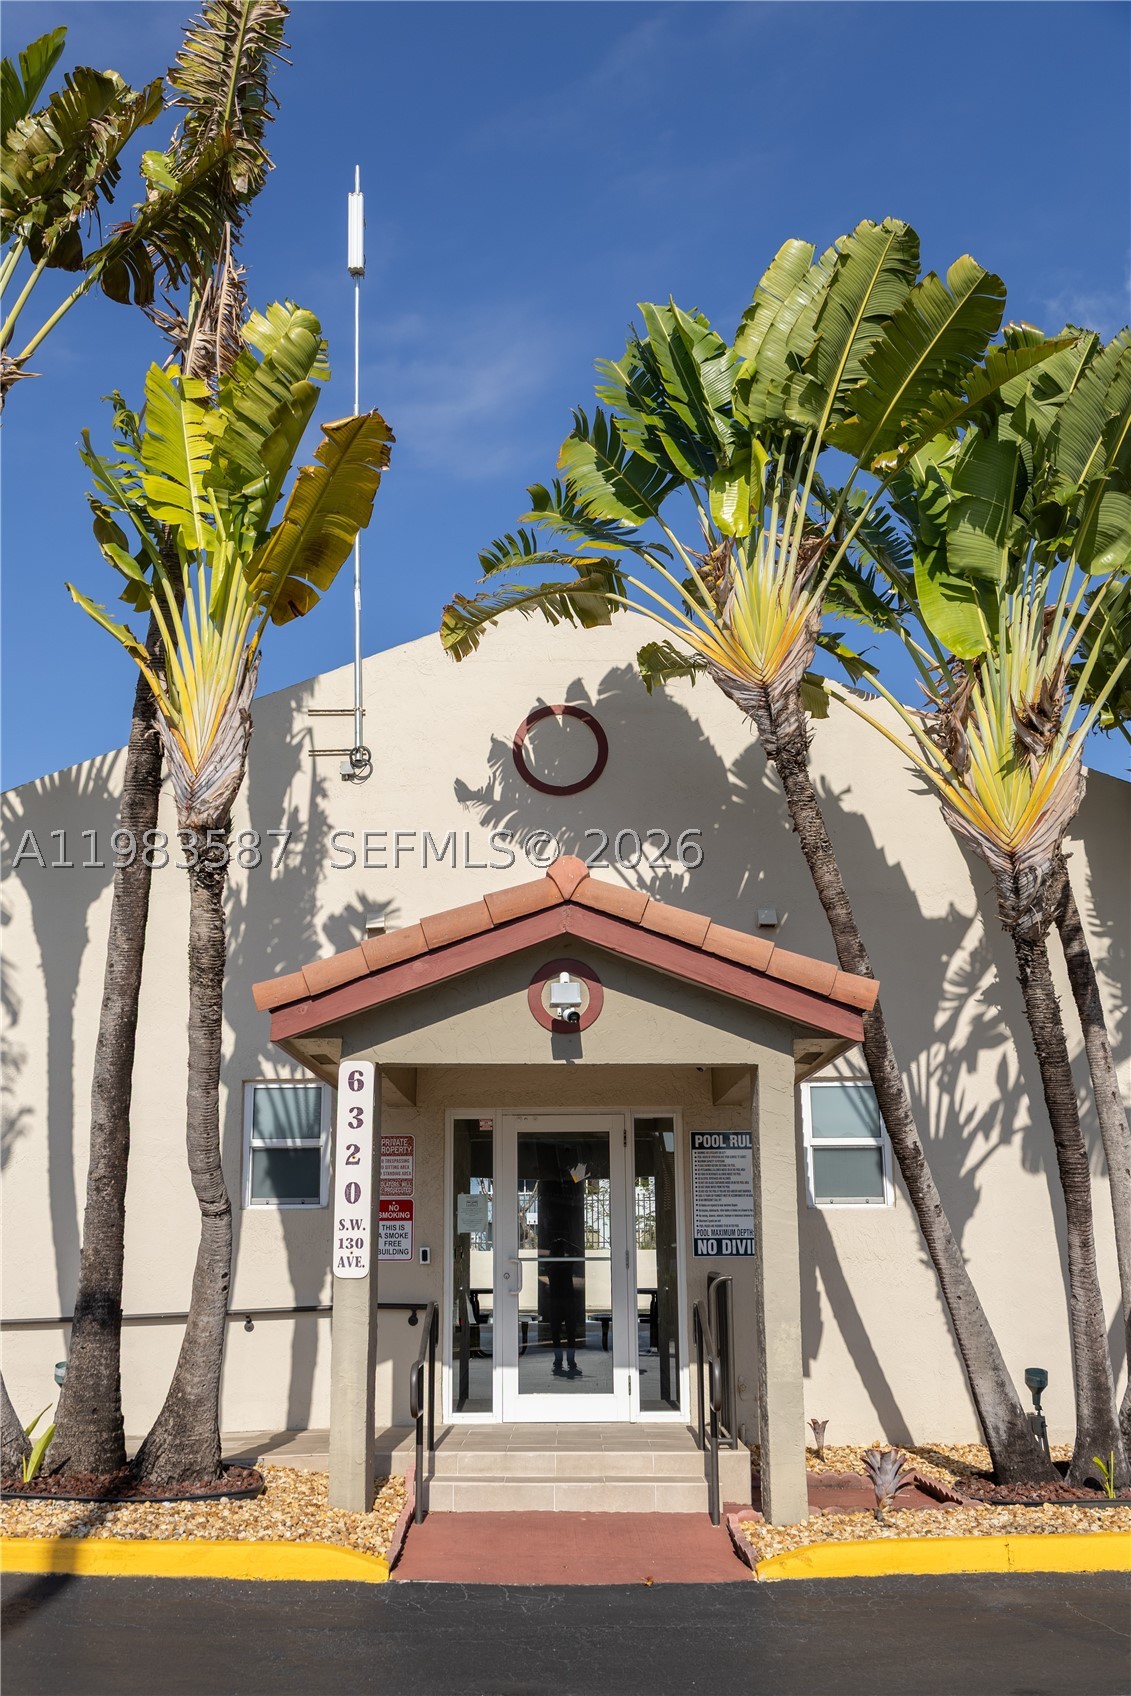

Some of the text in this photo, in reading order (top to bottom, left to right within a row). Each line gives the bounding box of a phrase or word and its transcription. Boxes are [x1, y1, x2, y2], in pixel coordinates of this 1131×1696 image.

[695, 1134, 752, 1148] POOL RUL
[381, 1146, 412, 1154] ROPERTY
[379, 1211, 411, 1219] SMOKING
[338, 1218, 366, 1231] S.W.
[697, 1228, 710, 1237] POOL
[711, 1228, 736, 1237] MAXIMUM
[338, 1237, 364, 1250] 130
[697, 1239, 755, 1255] NO DIVI
[379, 1248, 409, 1256] BUILDING
[337, 1256, 365, 1268] AVE.
